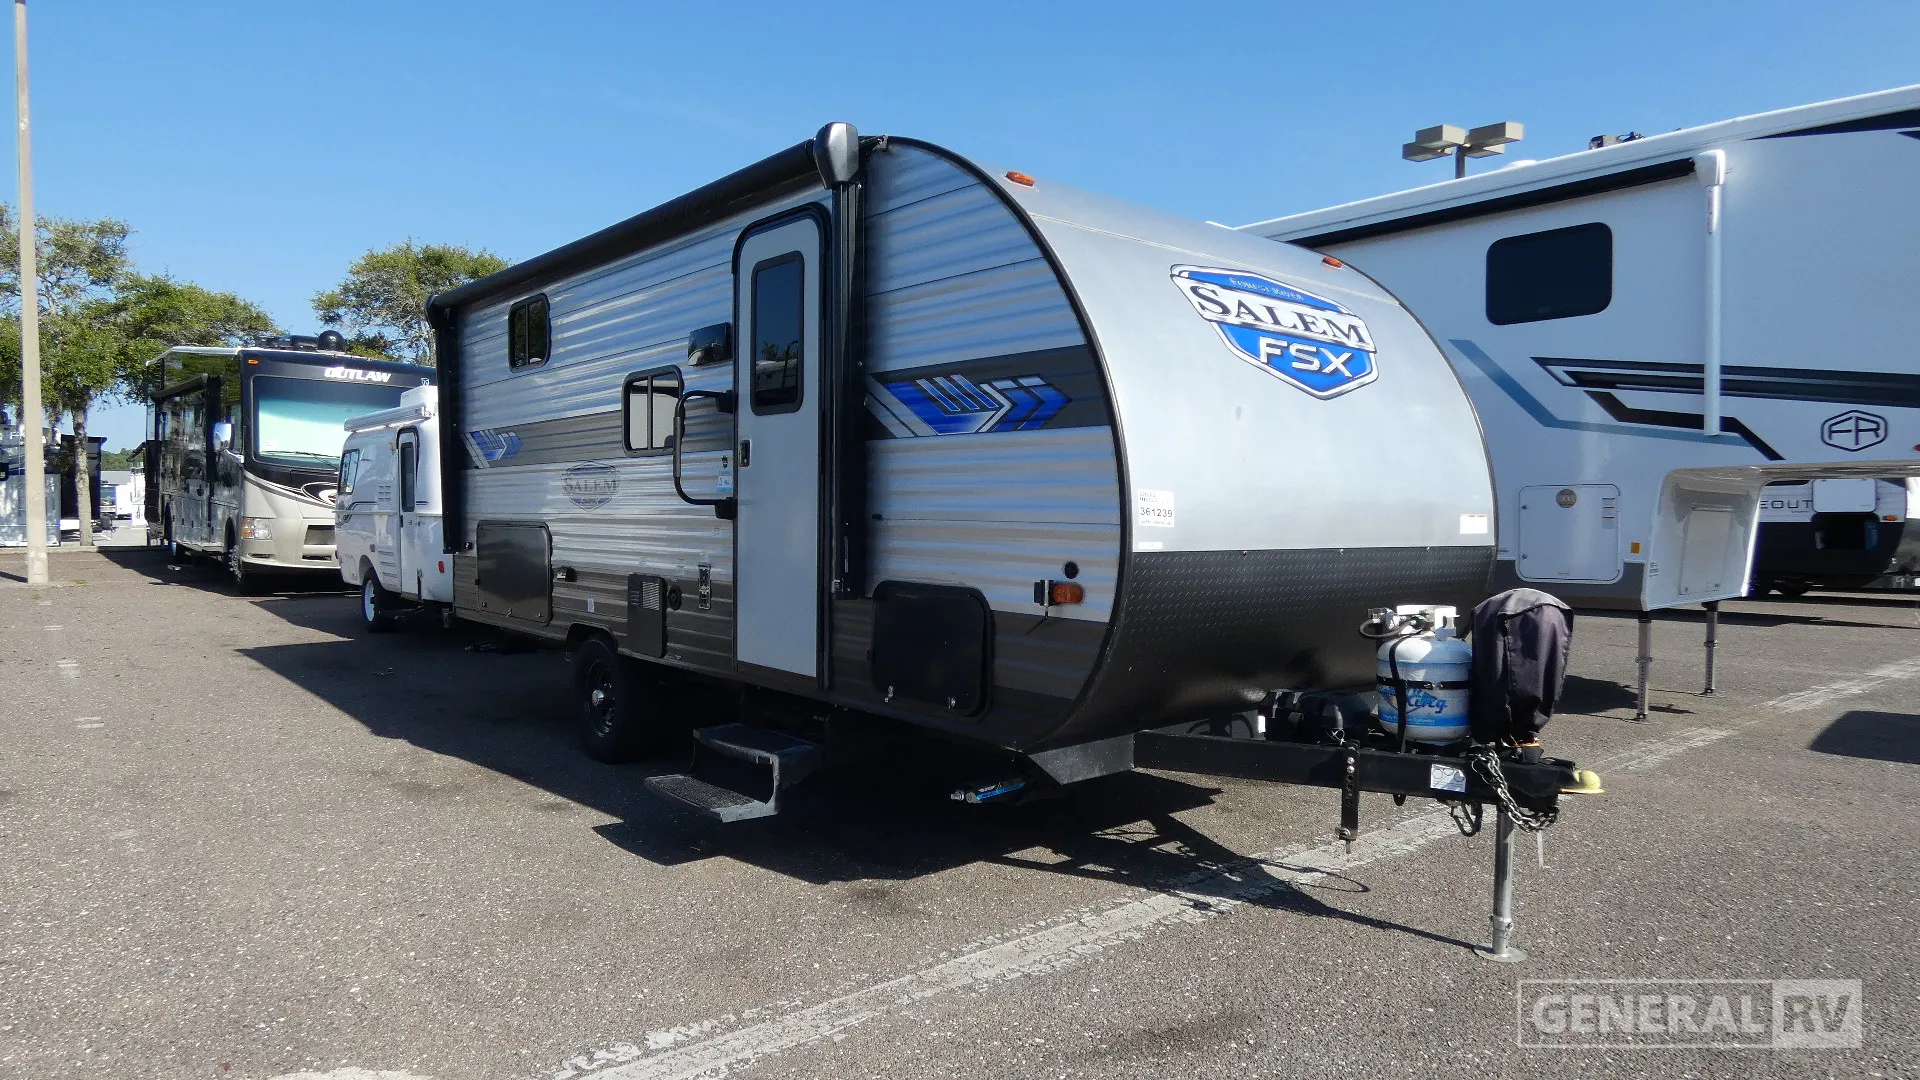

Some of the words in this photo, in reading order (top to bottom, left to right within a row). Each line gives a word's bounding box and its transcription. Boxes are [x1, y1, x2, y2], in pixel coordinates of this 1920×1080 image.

[1190, 285, 1370, 346] SALEM
[1259, 336, 1353, 377] FSX
[324, 366, 392, 383] OUTLAW
[562, 478, 619, 492] SALEM
[1140, 506, 1173, 518] 361239
